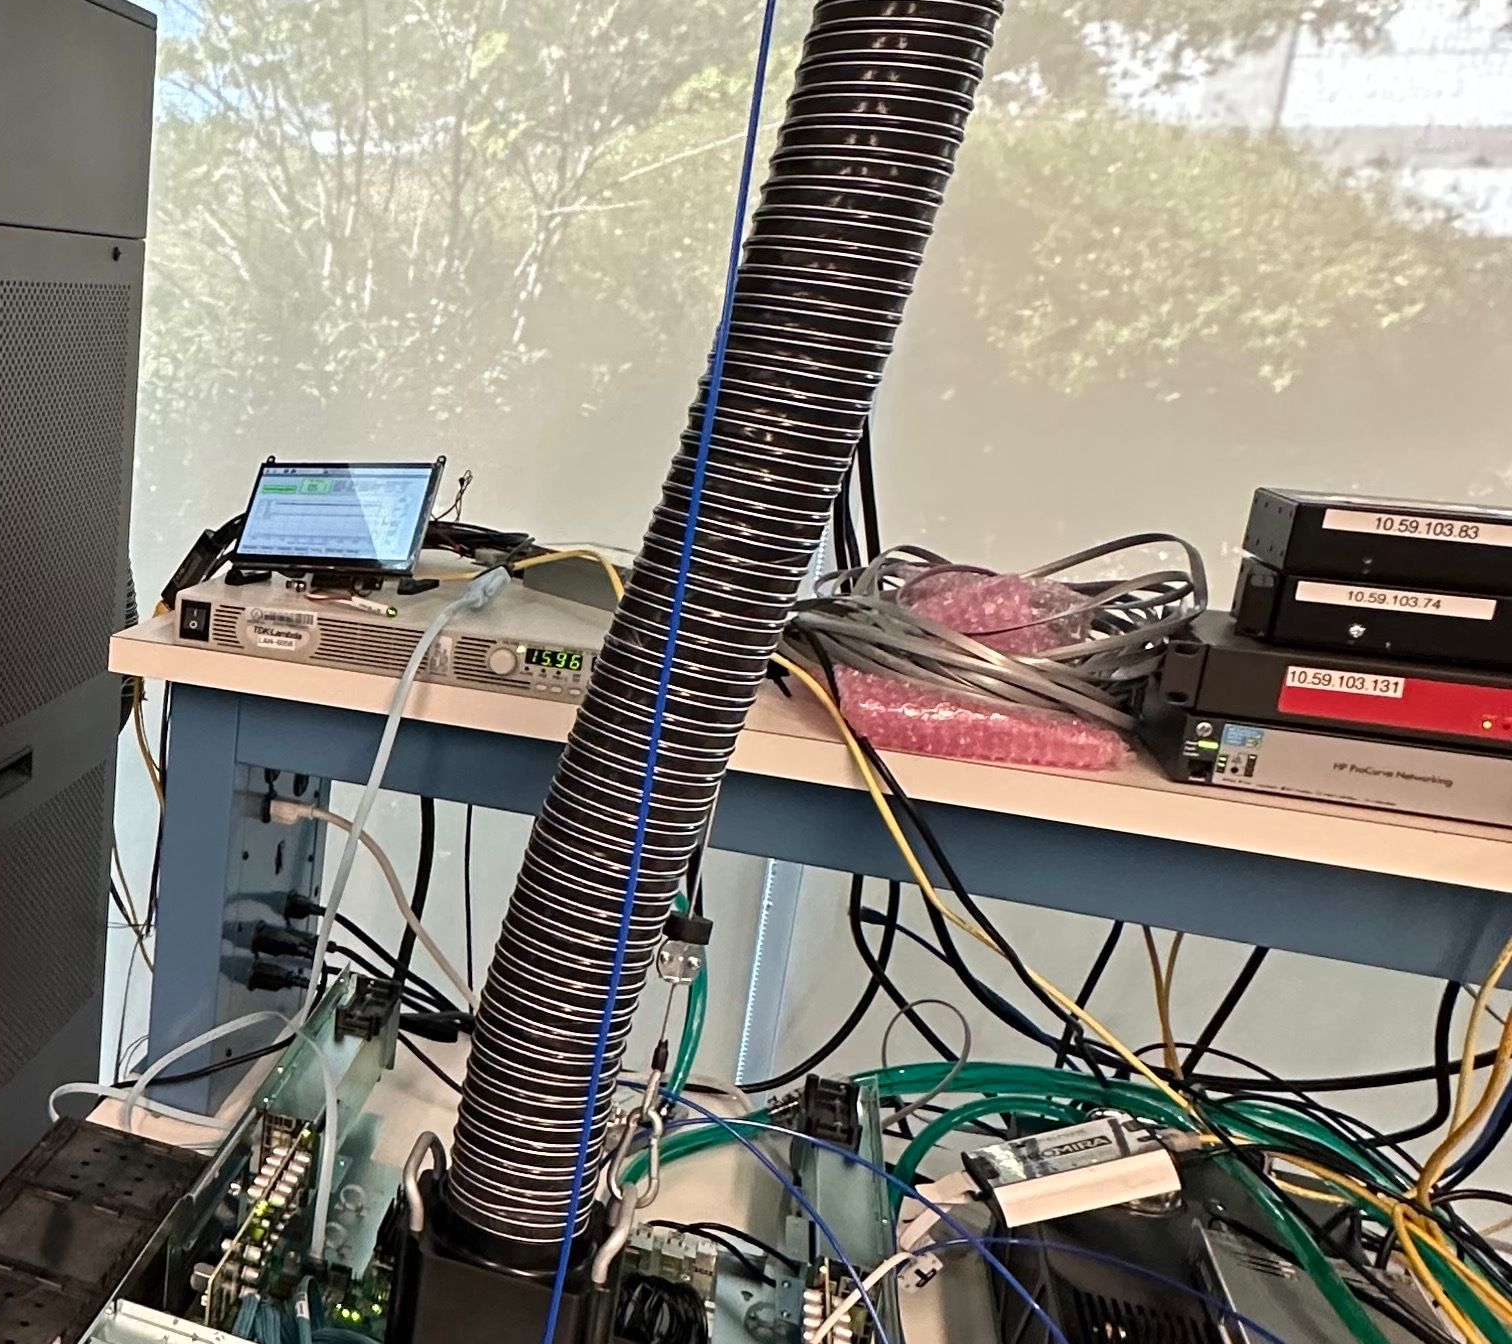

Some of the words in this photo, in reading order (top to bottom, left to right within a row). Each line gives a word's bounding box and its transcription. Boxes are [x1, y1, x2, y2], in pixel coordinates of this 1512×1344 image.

[1375, 516, 1480, 540] 10.59.103.83
[1347, 590, 1442, 610] 10.59.103.74
[1290, 669, 1400, 695] 10.59.103.131
